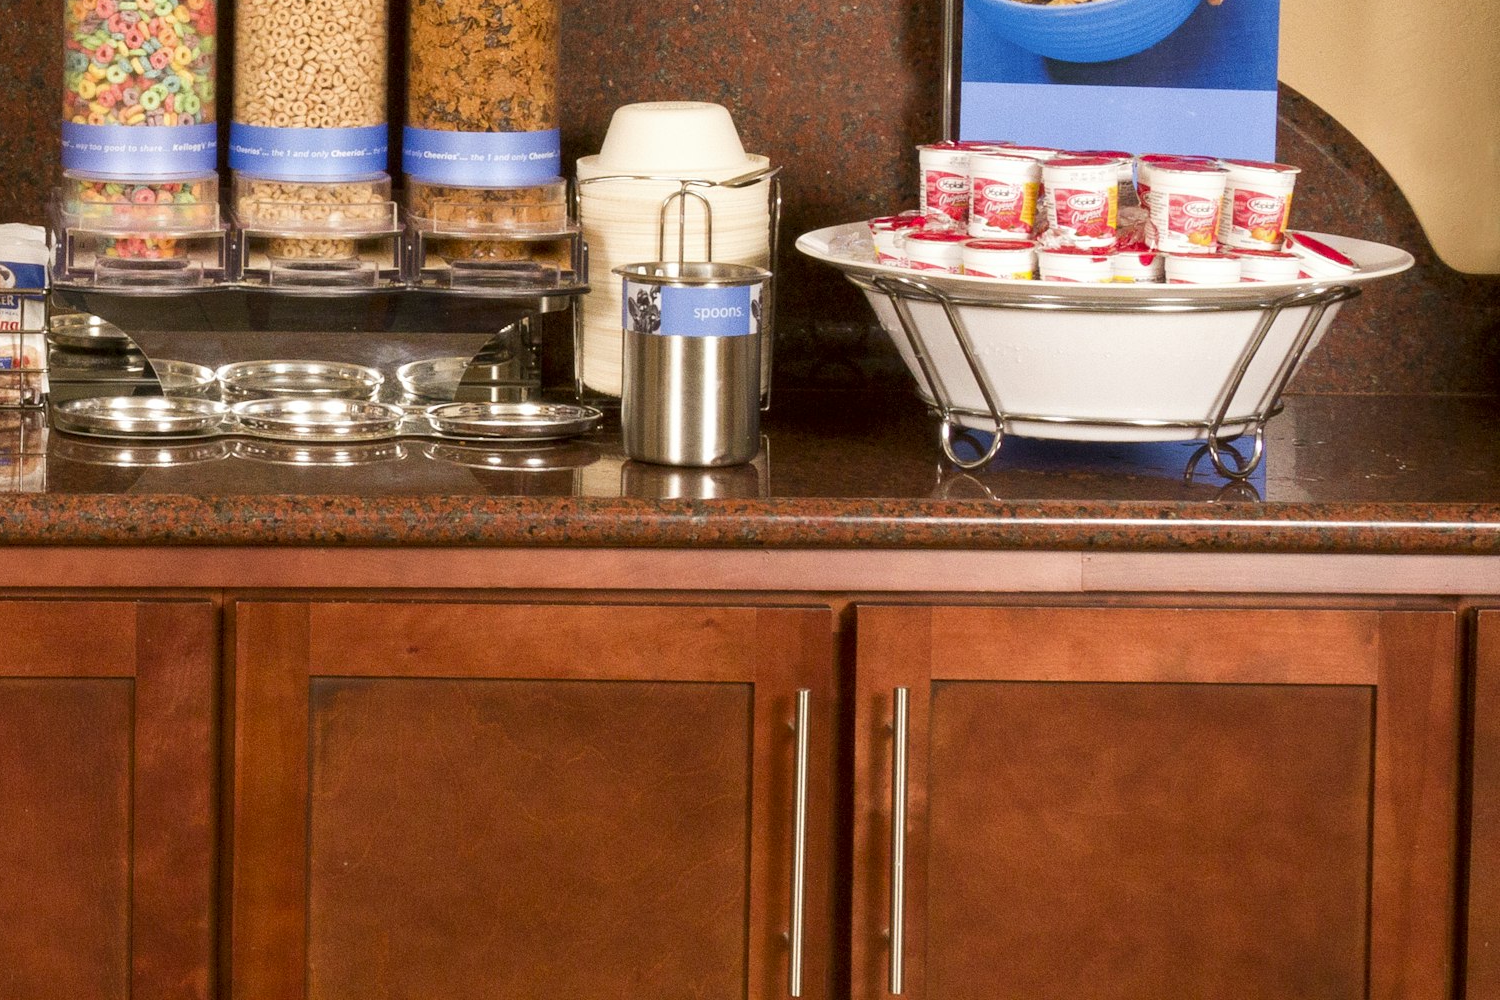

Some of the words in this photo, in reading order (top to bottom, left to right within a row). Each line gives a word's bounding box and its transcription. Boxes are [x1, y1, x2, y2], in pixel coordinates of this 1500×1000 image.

[104, 144, 126, 153] good
[128, 144, 138, 152] to
[271, 149, 284, 157] the
[293, 149, 309, 158] and
[311, 150, 329, 159] only
[470, 153, 484, 161] the
[493, 153, 510, 161] and
[511, 152, 527, 162] only
[694, 305, 744, 322] spoons.
